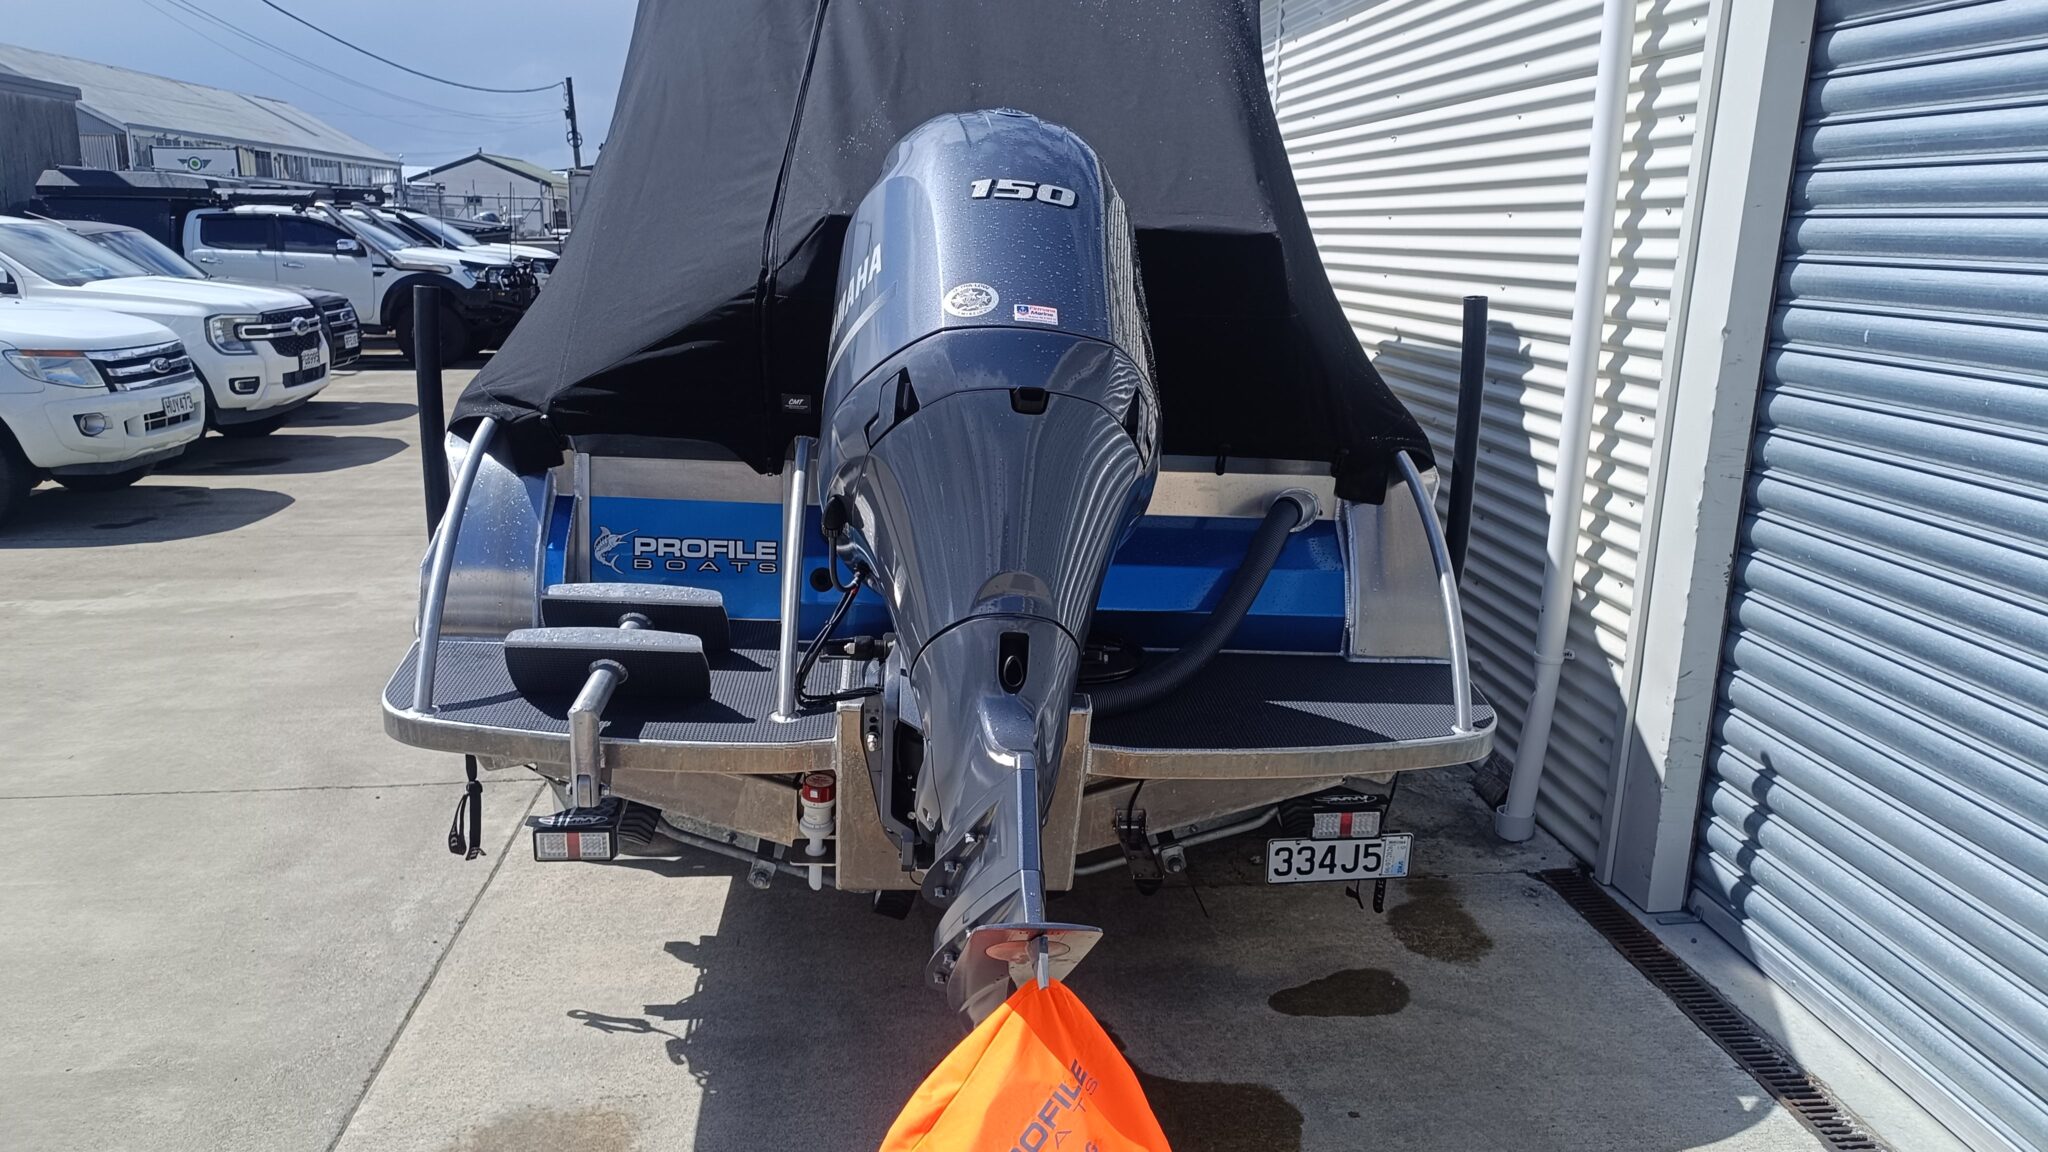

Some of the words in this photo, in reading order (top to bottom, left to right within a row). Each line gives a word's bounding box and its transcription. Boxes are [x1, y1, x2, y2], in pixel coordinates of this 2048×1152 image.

[971, 178, 1077, 208] 150
[633, 537, 777, 560] PROFILE
[633, 558, 777, 573] BOATS
[1273, 843, 1382, 877] 334J5
[1011, 1058, 1088, 1152] OFILE
